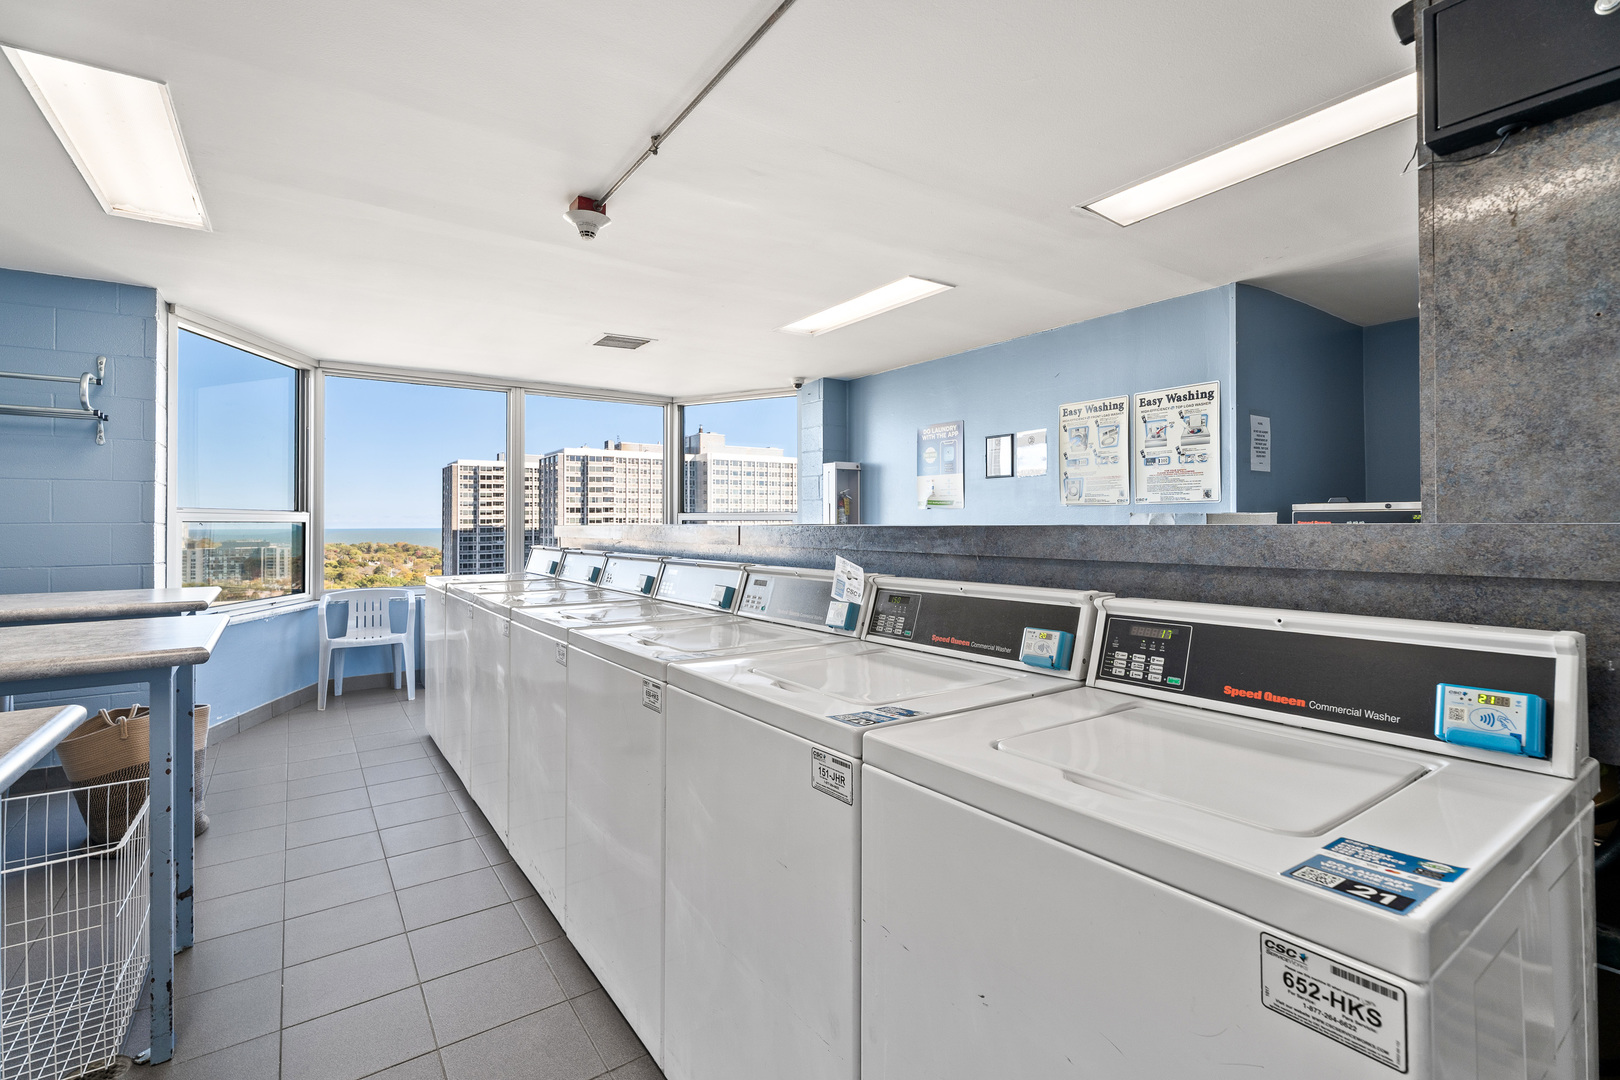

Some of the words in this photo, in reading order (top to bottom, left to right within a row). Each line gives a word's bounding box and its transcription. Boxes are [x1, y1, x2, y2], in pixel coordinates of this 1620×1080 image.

[1139, 397, 1163, 407] Easy
[1166, 390, 1215, 403] Washing
[1062, 408, 1082, 417] Easy
[1085, 402, 1124, 413] Washing
[931, 634, 950, 643] Speed
[950, 637, 970, 646] Queen
[970, 641, 996, 651] Commercial
[995, 645, 1012, 653] Washer
[1223, 685, 1262, 700] Speed
[1263, 691, 1306, 707] Queen
[1308, 700, 1362, 717] Commercial
[1364, 709, 1401, 724] Washer
[1478, 694, 1495, 705] 21
[818, 766, 846, 786] 151-JHR
[1345, 884, 1398, 905] 21
[1264, 939, 1297, 959] CSC
[1282, 971, 1382, 1028] 652-HKS
